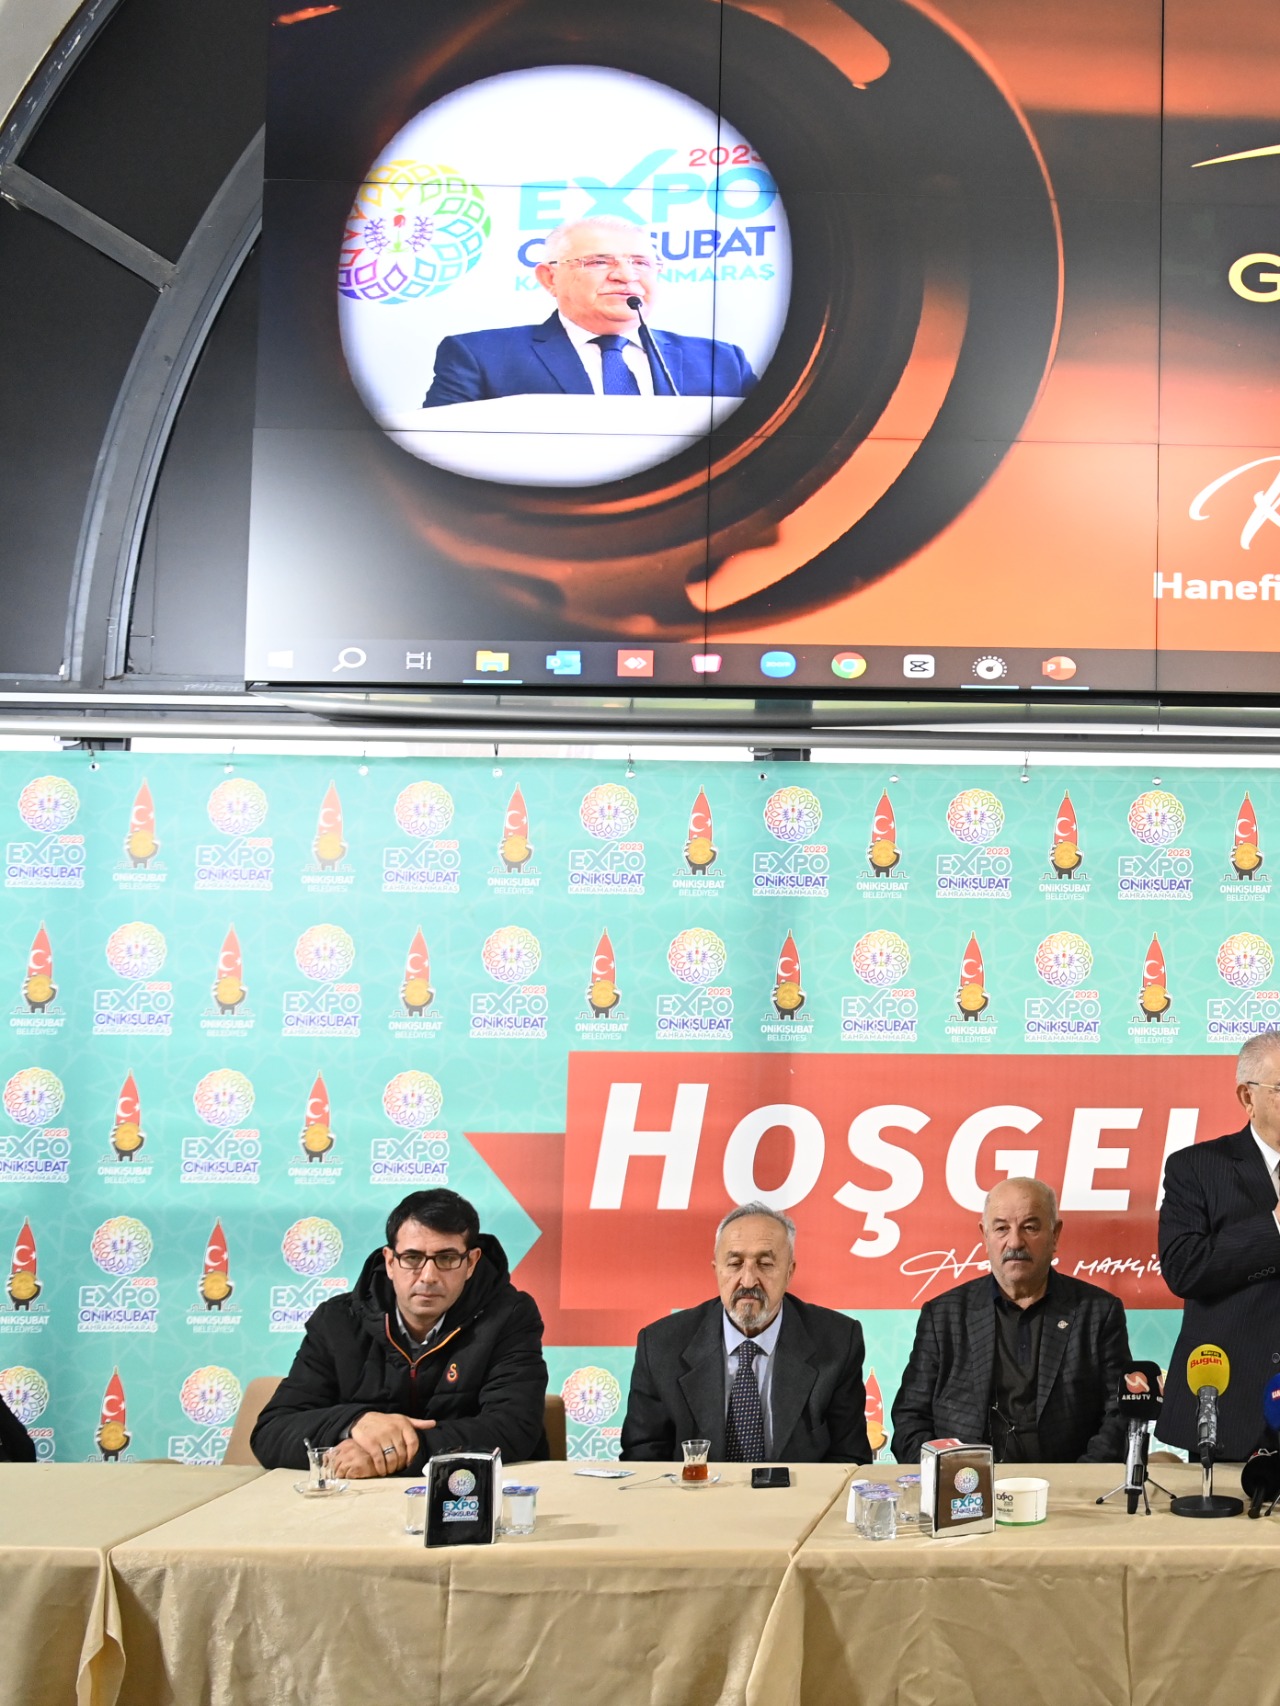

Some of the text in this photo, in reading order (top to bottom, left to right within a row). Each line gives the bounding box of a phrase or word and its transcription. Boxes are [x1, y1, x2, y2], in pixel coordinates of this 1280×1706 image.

[518, 148, 778, 230] EXPO
[8, 835, 83, 864] EXPO
[571, 843, 646, 872] EXPO
[756, 845, 827, 873] EXPO
[803, 845, 826, 853] 2023
[939, 847, 1010, 875] EXPO
[986, 847, 1009, 855] 2023
[1120, 848, 1191, 876] EXPO
[1167, 849, 1190, 857] 2023
[96, 981, 173, 1010] EXPO
[286, 984, 361, 1013] EXPO
[473, 986, 548, 1015] EXPO
[660, 987, 731, 1016] EXPO
[707, 988, 730, 996] 2023
[844, 988, 916, 1017] EXPO
[891, 989, 915, 997] 2023
[1028, 990, 1099, 1018] EXPO
[1075, 990, 1098, 998] 2023
[1210, 991, 1280, 1019] EXPO
[1257, 991, 1280, 999] 2023
[183, 1130, 260, 1160] EXPO
[374, 1132, 449, 1161] EXPO
[81, 1278, 158, 1308] EXPO
[170, 1428, 225, 1457] EXP
[567, 1427, 621, 1457] XPO
[602, 1428, 622, 1436] 202
[444, 1497, 479, 1510] EXPO
[951, 1494, 983, 1508] EXPO
